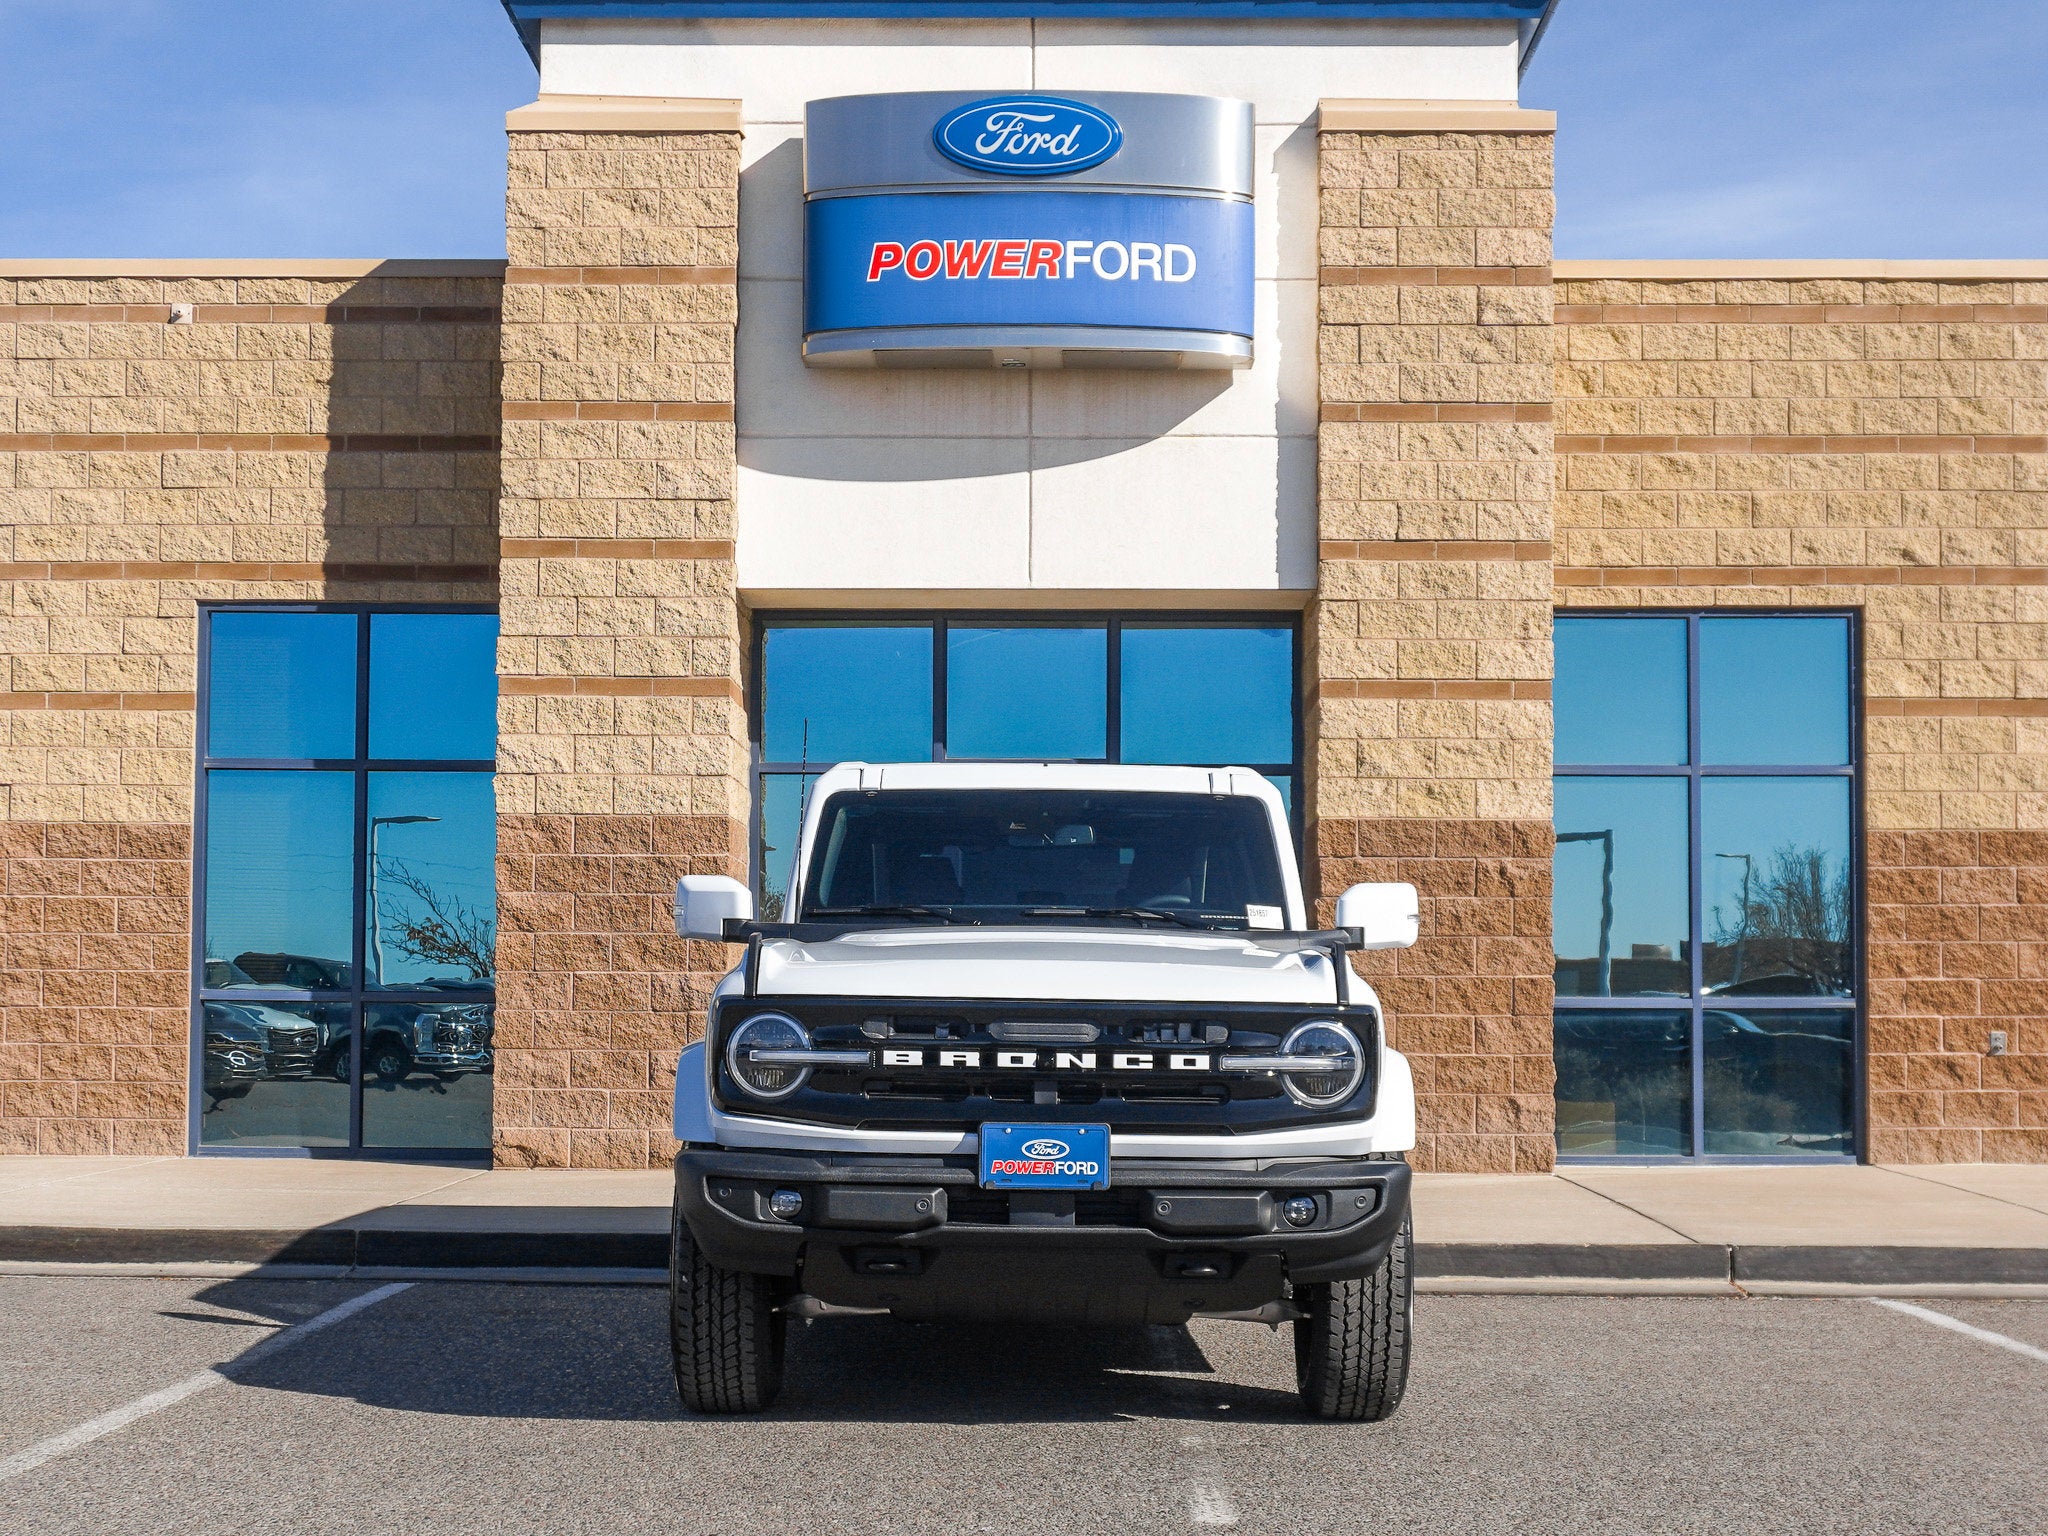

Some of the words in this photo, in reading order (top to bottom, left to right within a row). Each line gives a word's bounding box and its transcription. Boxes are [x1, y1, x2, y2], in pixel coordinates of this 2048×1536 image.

[975, 111, 1082, 156] Ford
[883, 1050, 1210, 1069] BRONCO
[1031, 1142, 1060, 1155] Ford
